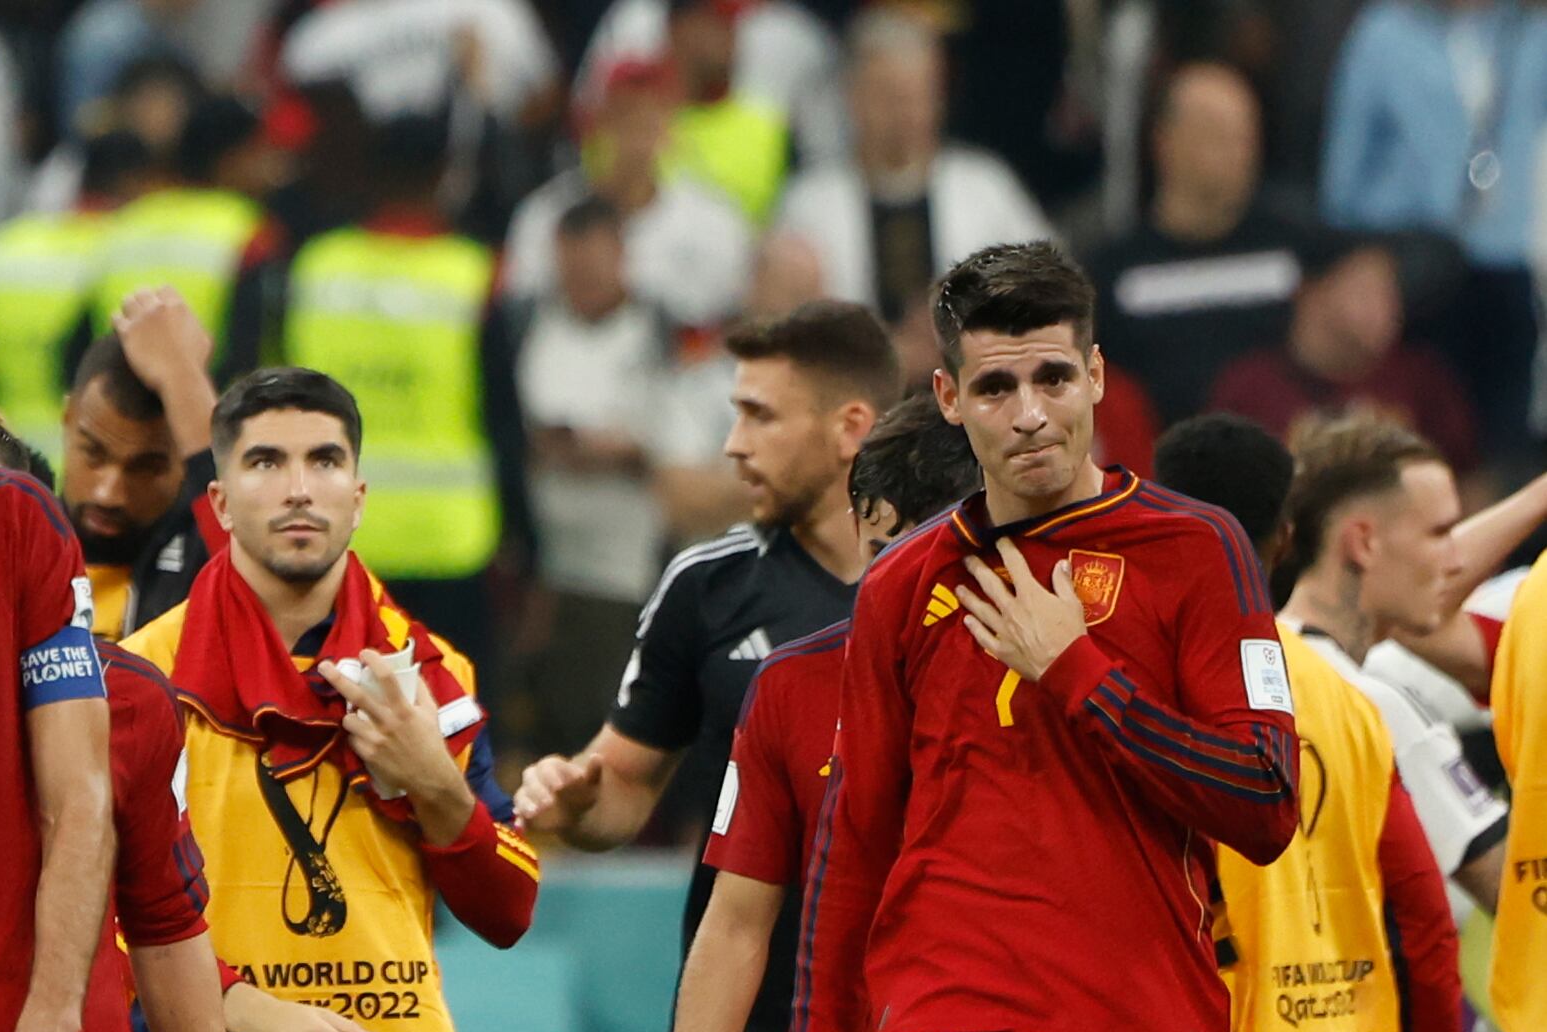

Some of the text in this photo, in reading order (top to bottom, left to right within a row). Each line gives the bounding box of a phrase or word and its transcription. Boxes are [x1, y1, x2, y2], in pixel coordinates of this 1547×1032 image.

[20, 646, 90, 669] SAVE THE
[22, 660, 93, 688] PLANET
[262, 961, 374, 988] WORLD
[380, 960, 429, 985] CUP
